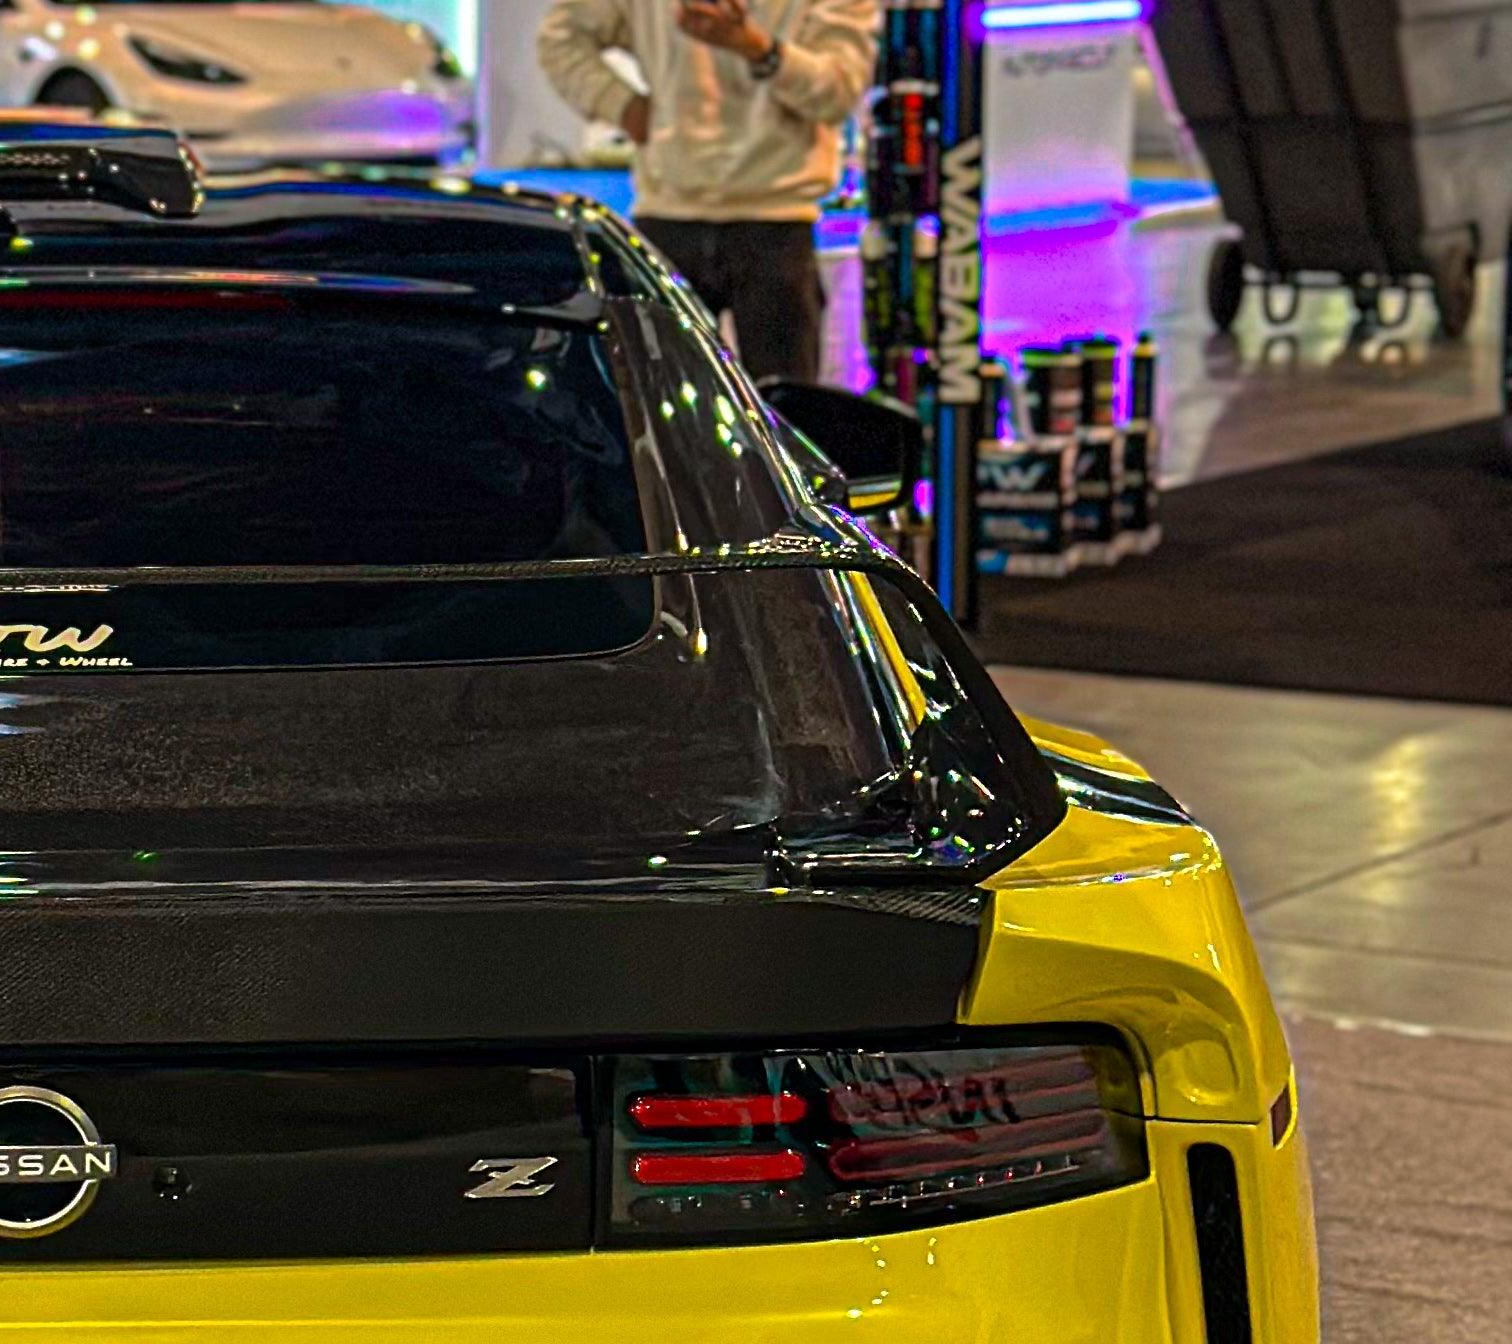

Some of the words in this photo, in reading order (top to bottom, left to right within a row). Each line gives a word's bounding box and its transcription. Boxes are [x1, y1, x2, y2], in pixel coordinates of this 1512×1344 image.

[938, 135, 983, 403] WABAM
[59, 656, 133, 667] WHEEL
[464, 1156, 559, 1198] Z
